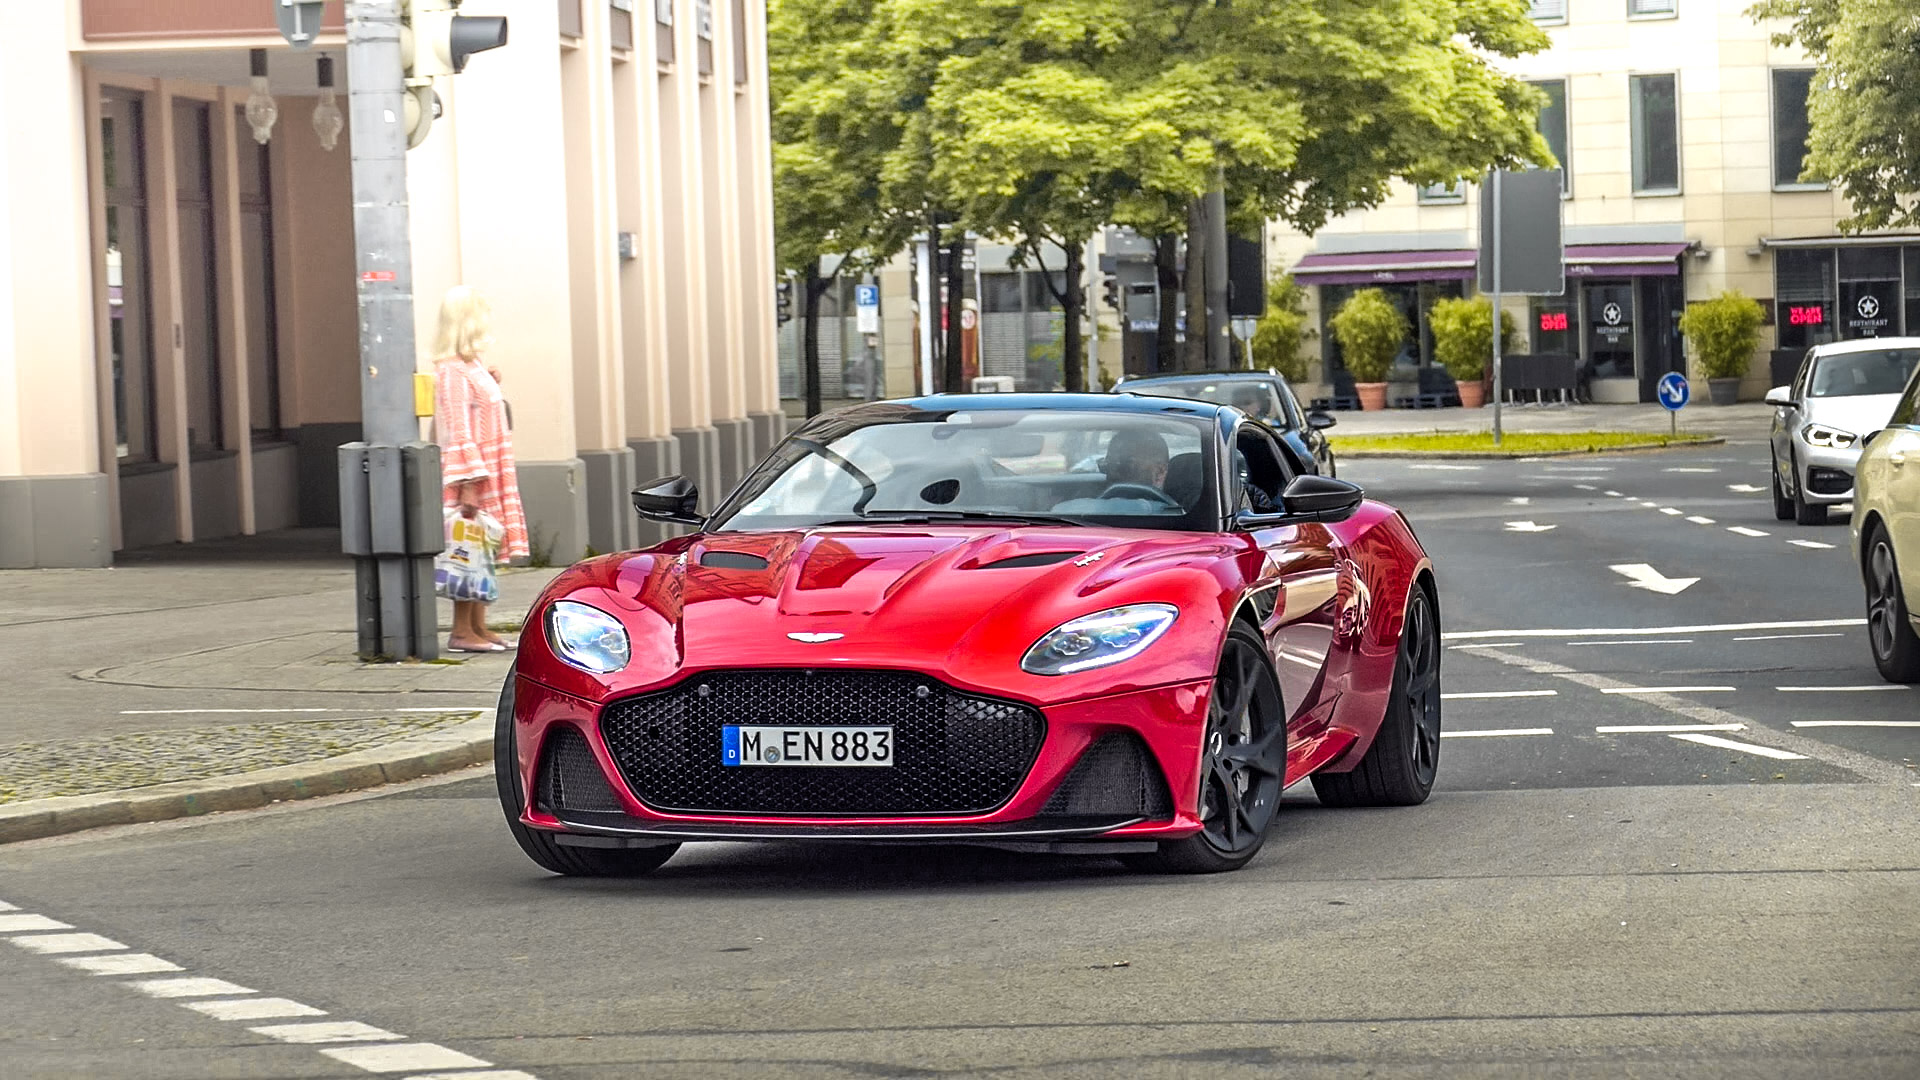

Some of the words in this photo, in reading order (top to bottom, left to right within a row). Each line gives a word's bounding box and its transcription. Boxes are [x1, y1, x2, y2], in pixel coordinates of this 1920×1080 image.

[860, 287, 873, 304] P
[1790, 313, 1823, 324] OPEN
[1541, 319, 1568, 330] OPEN
[742, 731, 762, 761] M
[783, 731, 823, 761] EN
[831, 731, 890, 762] 883
[728, 749, 736, 759] D
